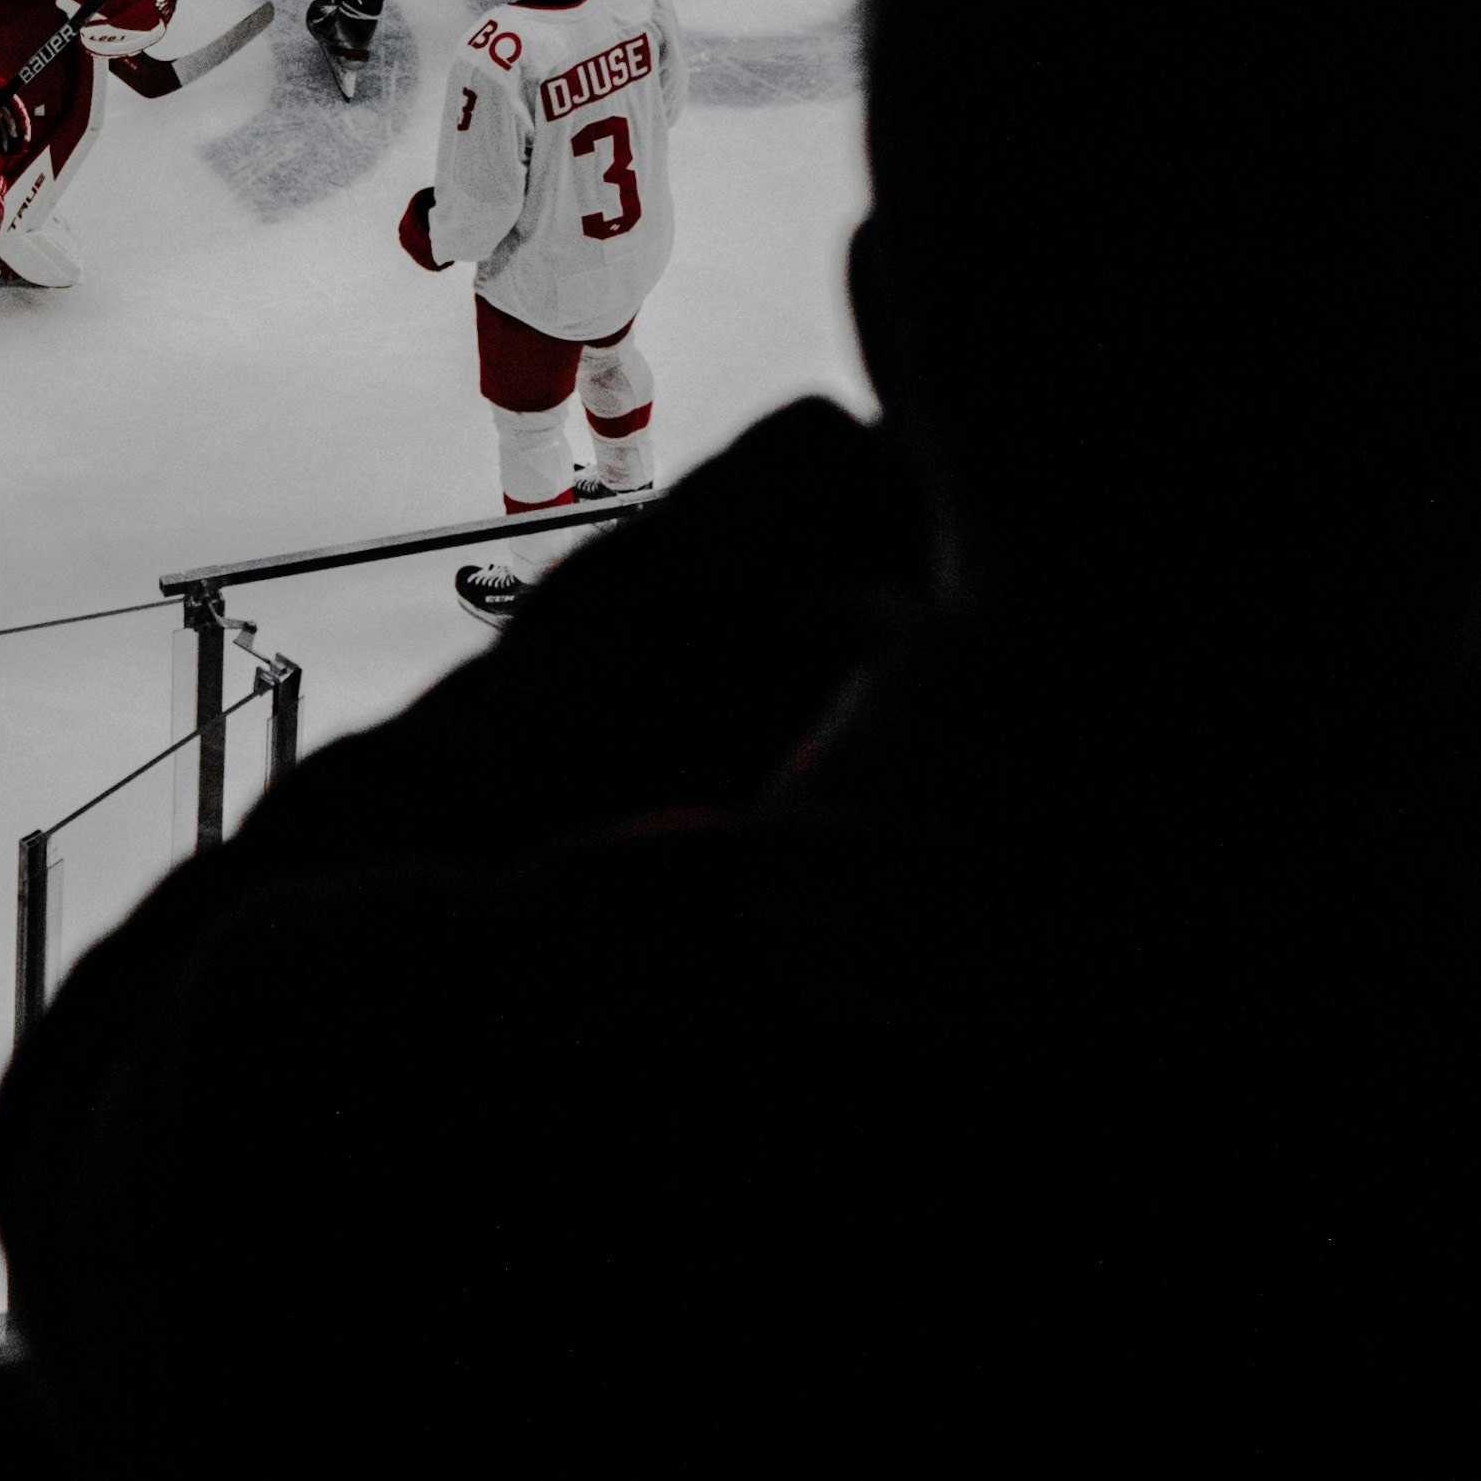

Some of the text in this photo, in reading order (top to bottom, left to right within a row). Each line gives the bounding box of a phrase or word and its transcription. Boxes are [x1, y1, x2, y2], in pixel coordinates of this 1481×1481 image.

[467, 19, 523, 71] BQ
[548, 40, 651, 118] DJUSE
[570, 116, 643, 241] 3
